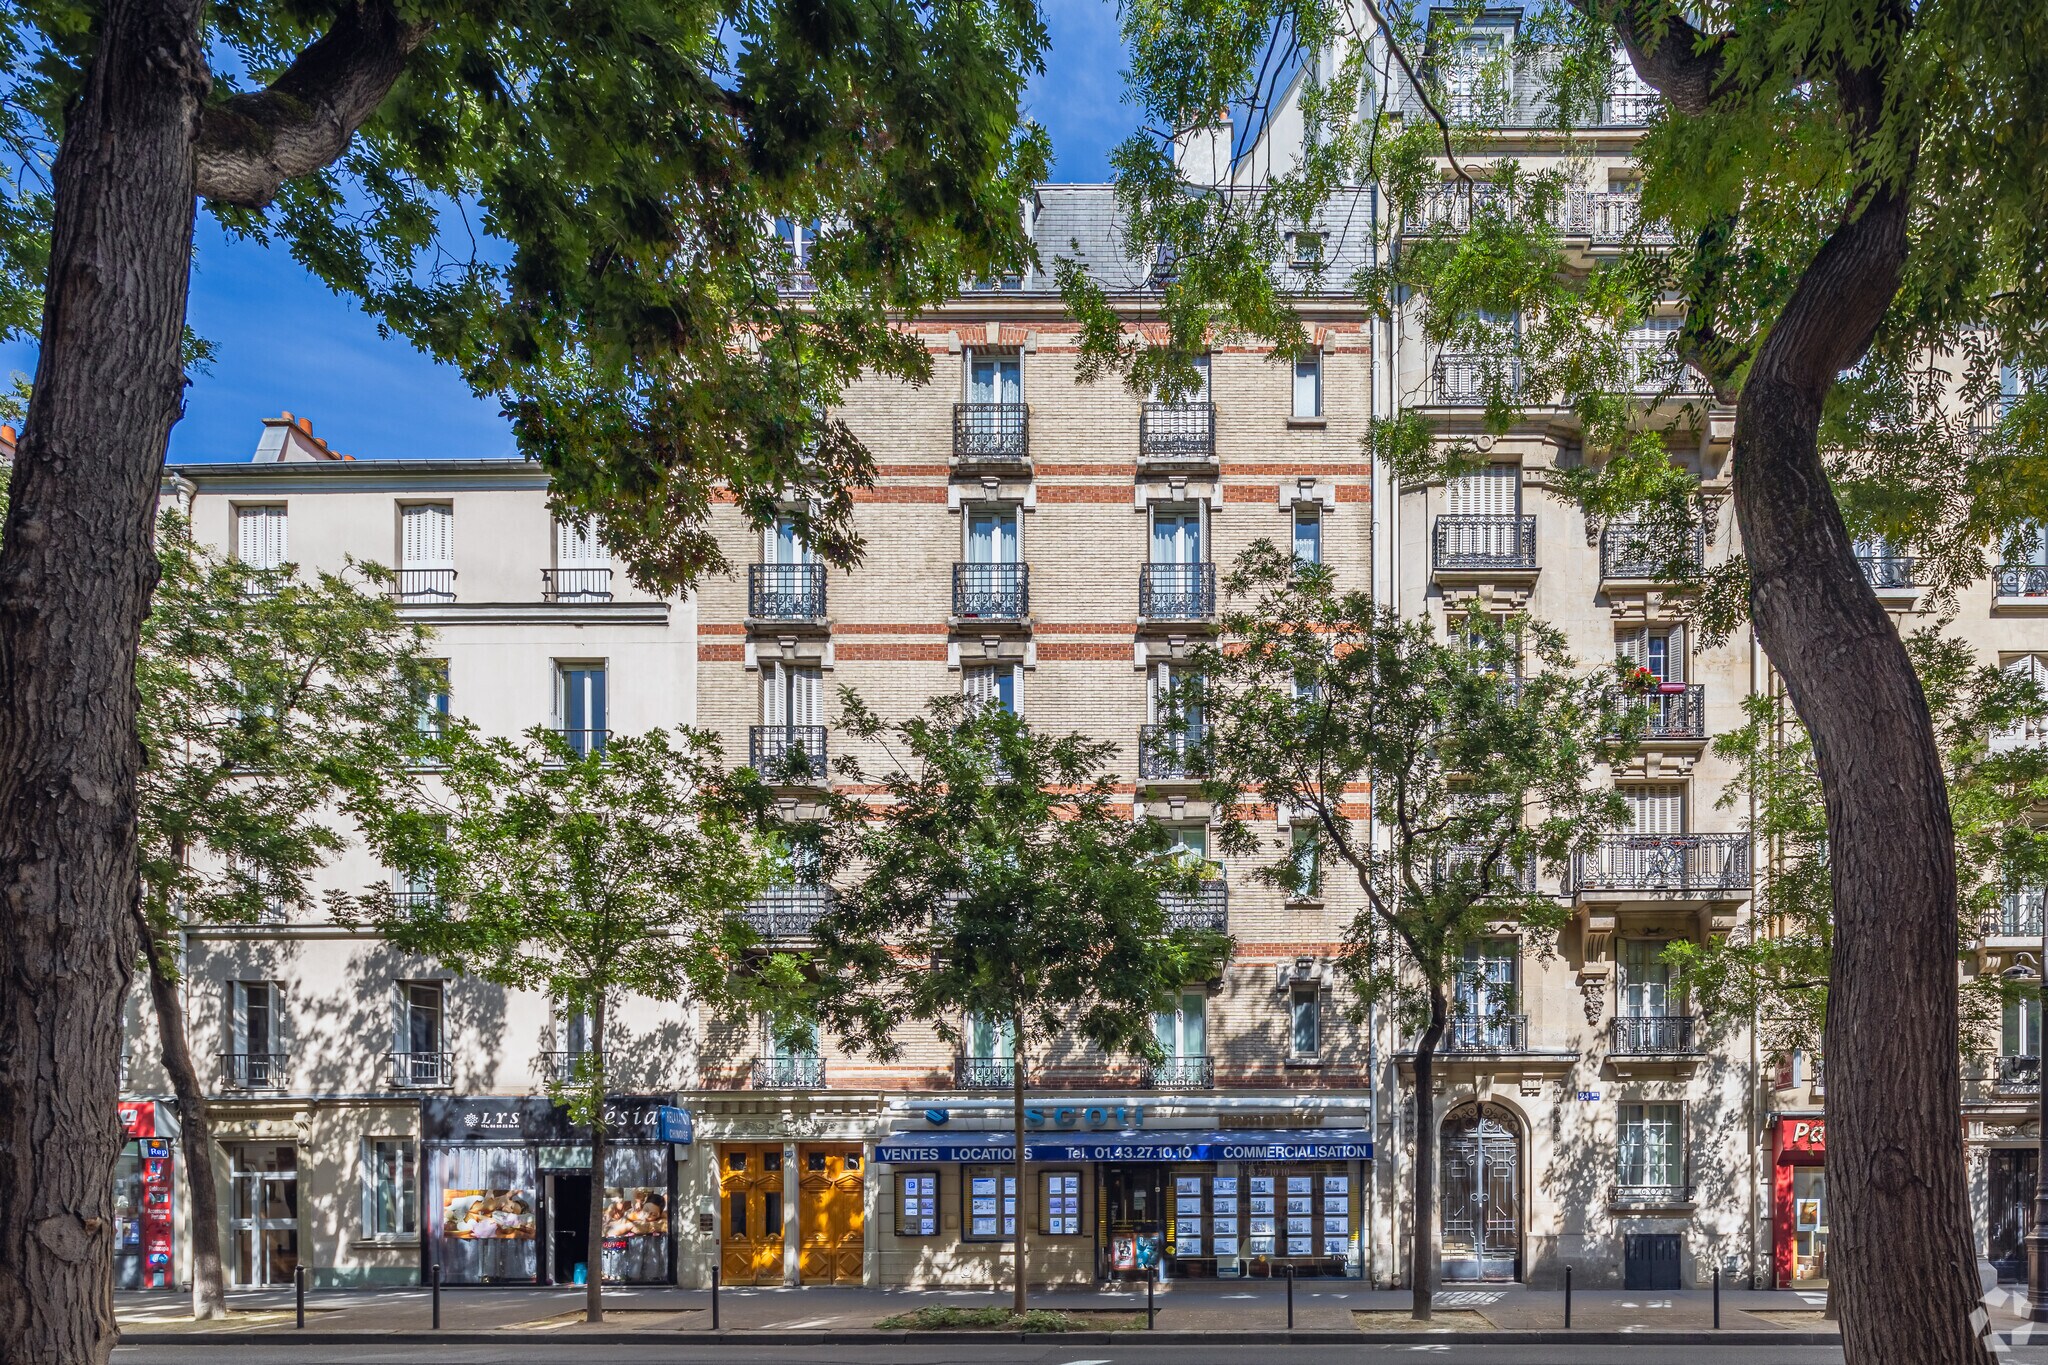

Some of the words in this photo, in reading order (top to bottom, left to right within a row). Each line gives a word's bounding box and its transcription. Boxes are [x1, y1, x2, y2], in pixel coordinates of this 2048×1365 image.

[481, 1112, 520, 1124] LYS
[568, 1105, 659, 1126] ésia
[1793, 1122, 1825, 1142] Pa
[882, 1148, 939, 1161] VENTES
[951, 1148, 1033, 1160] LOCATIOS
[1065, 1147, 1088, 1159] Tel.
[1094, 1147, 1192, 1159] 01.43.27.10.10
[1223, 1146, 1367, 1159] COMMERCIALISATION
